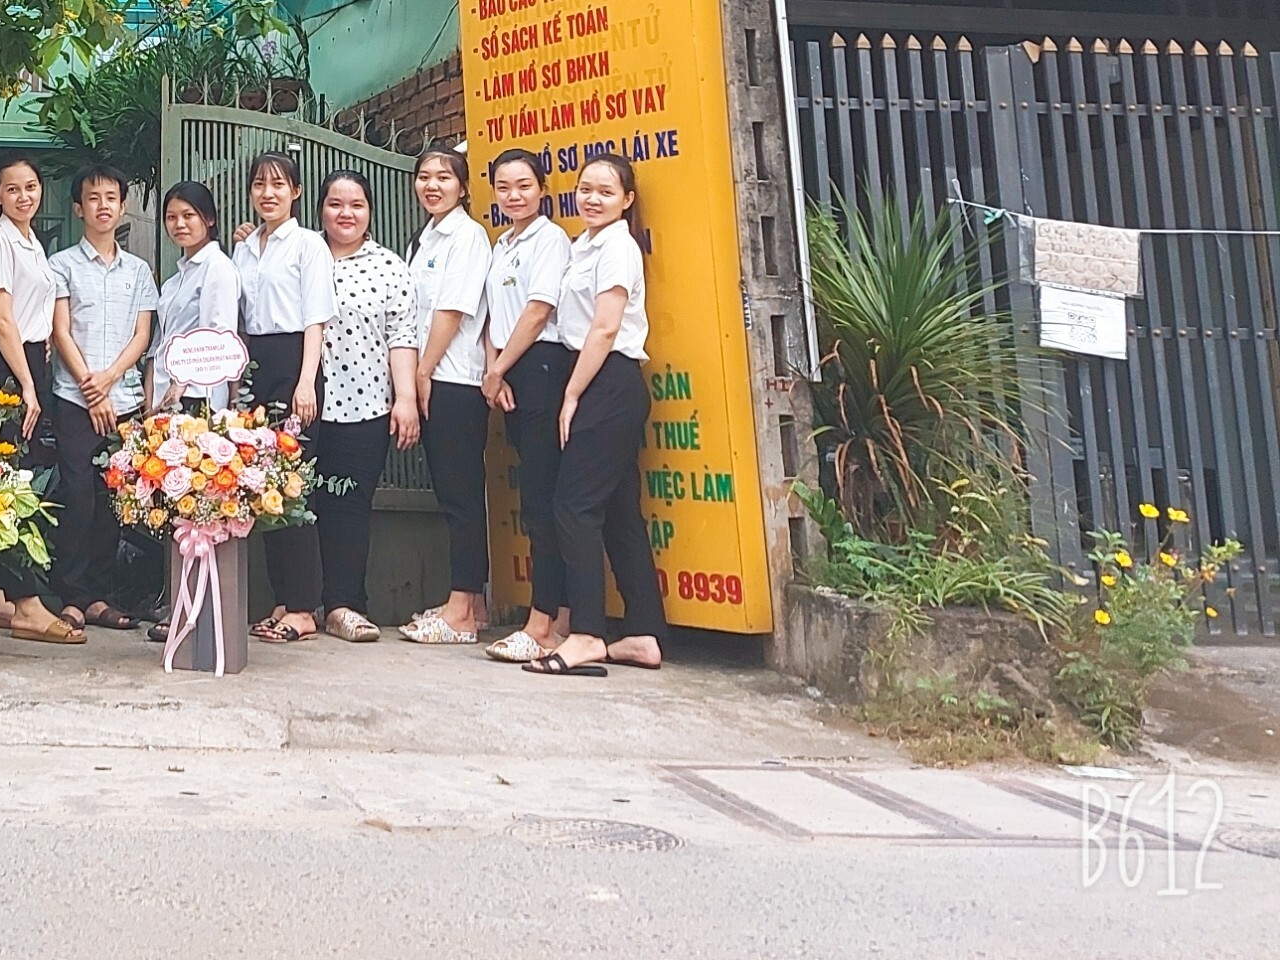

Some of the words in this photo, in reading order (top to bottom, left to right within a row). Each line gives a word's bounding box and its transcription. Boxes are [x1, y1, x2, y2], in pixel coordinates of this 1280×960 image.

[481, 24, 499, 61] SỔ
[501, 24, 538, 56] SÁCH
[542, 10, 563, 47] KẾ
[566, 4, 609, 39] TOÁN
[483, 71, 515, 102] LÀM
[519, 60, 538, 94] HỒ
[542, 58, 561, 89] SƠ
[566, 50, 610, 84] BHXH
[486, 114, 505, 143] TƯ
[509, 104, 539, 138] VẤN
[541, 100, 575, 133] LÀM
[580, 90, 601, 125] HỒ
[605, 89, 627, 120] SƠ
[631, 84, 667, 115] VAY
[558, 142, 578, 174] SƠ
[621, 130, 650, 163] LÁI
[656, 130, 680, 158] XE
[651, 363, 692, 402] SẢN
[652, 409, 701, 451] THUẾ
[645, 463, 686, 506] VIỆC
[690, 464, 735, 503] LÀM
[646, 513, 674, 556] ẬP
[677, 570, 743, 605] 8939
